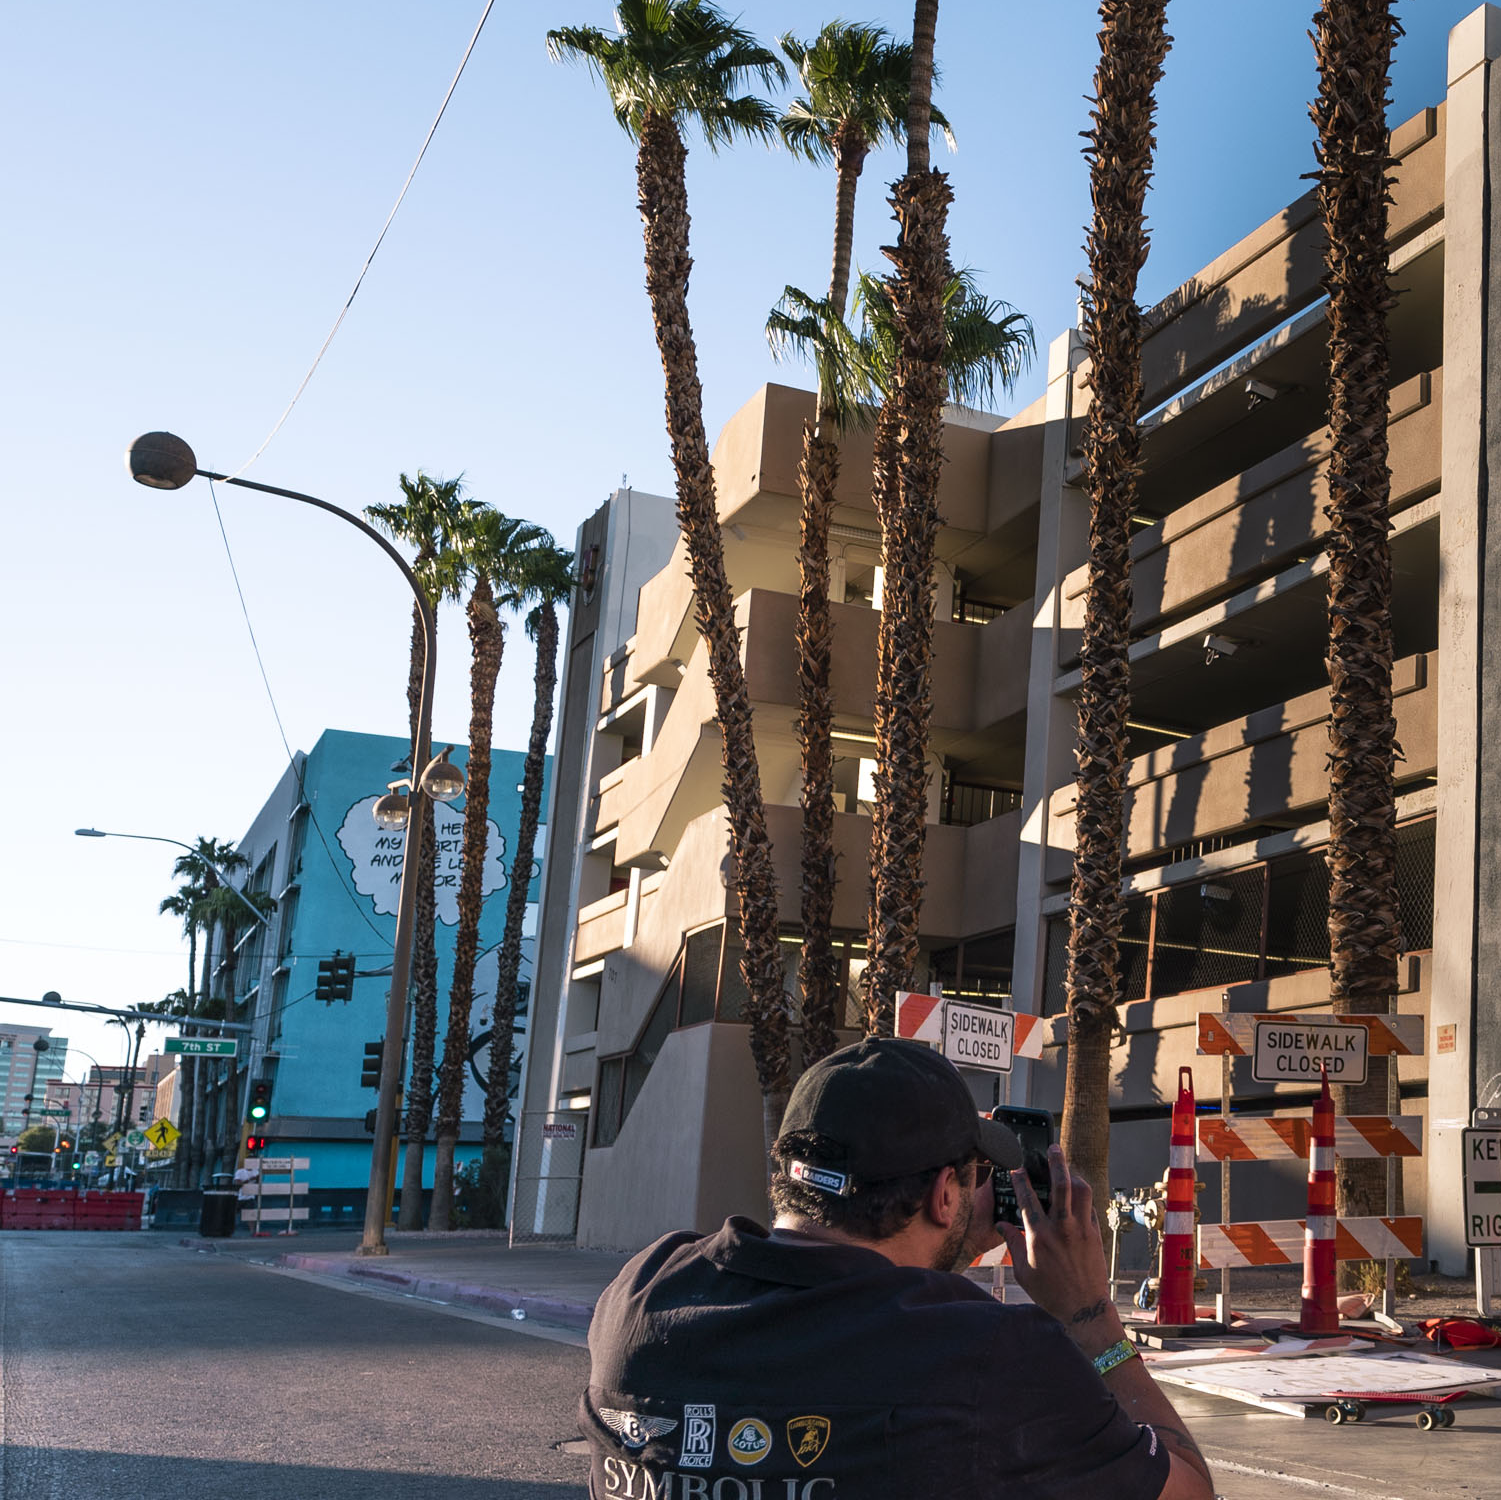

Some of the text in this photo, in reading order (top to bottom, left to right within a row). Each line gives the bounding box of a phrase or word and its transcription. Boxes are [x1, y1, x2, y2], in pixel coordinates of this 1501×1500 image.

[375, 836, 403, 850] MY
[370, 854, 404, 868] AND
[951, 1012, 1008, 1039] SIDEWALK
[181, 1042, 222, 1052] 7th ST
[1267, 1031, 1356, 1052] SIDEWALK
[957, 1037, 1001, 1061] CLOSED
[1276, 1055, 1345, 1073] CLOSED
[803, 1169, 840, 1188] RAIDERS
[686, 1407, 713, 1417] ROLLS
[733, 1438, 767, 1450] LOTUS
[680, 1456, 711, 1466] ROYCE
